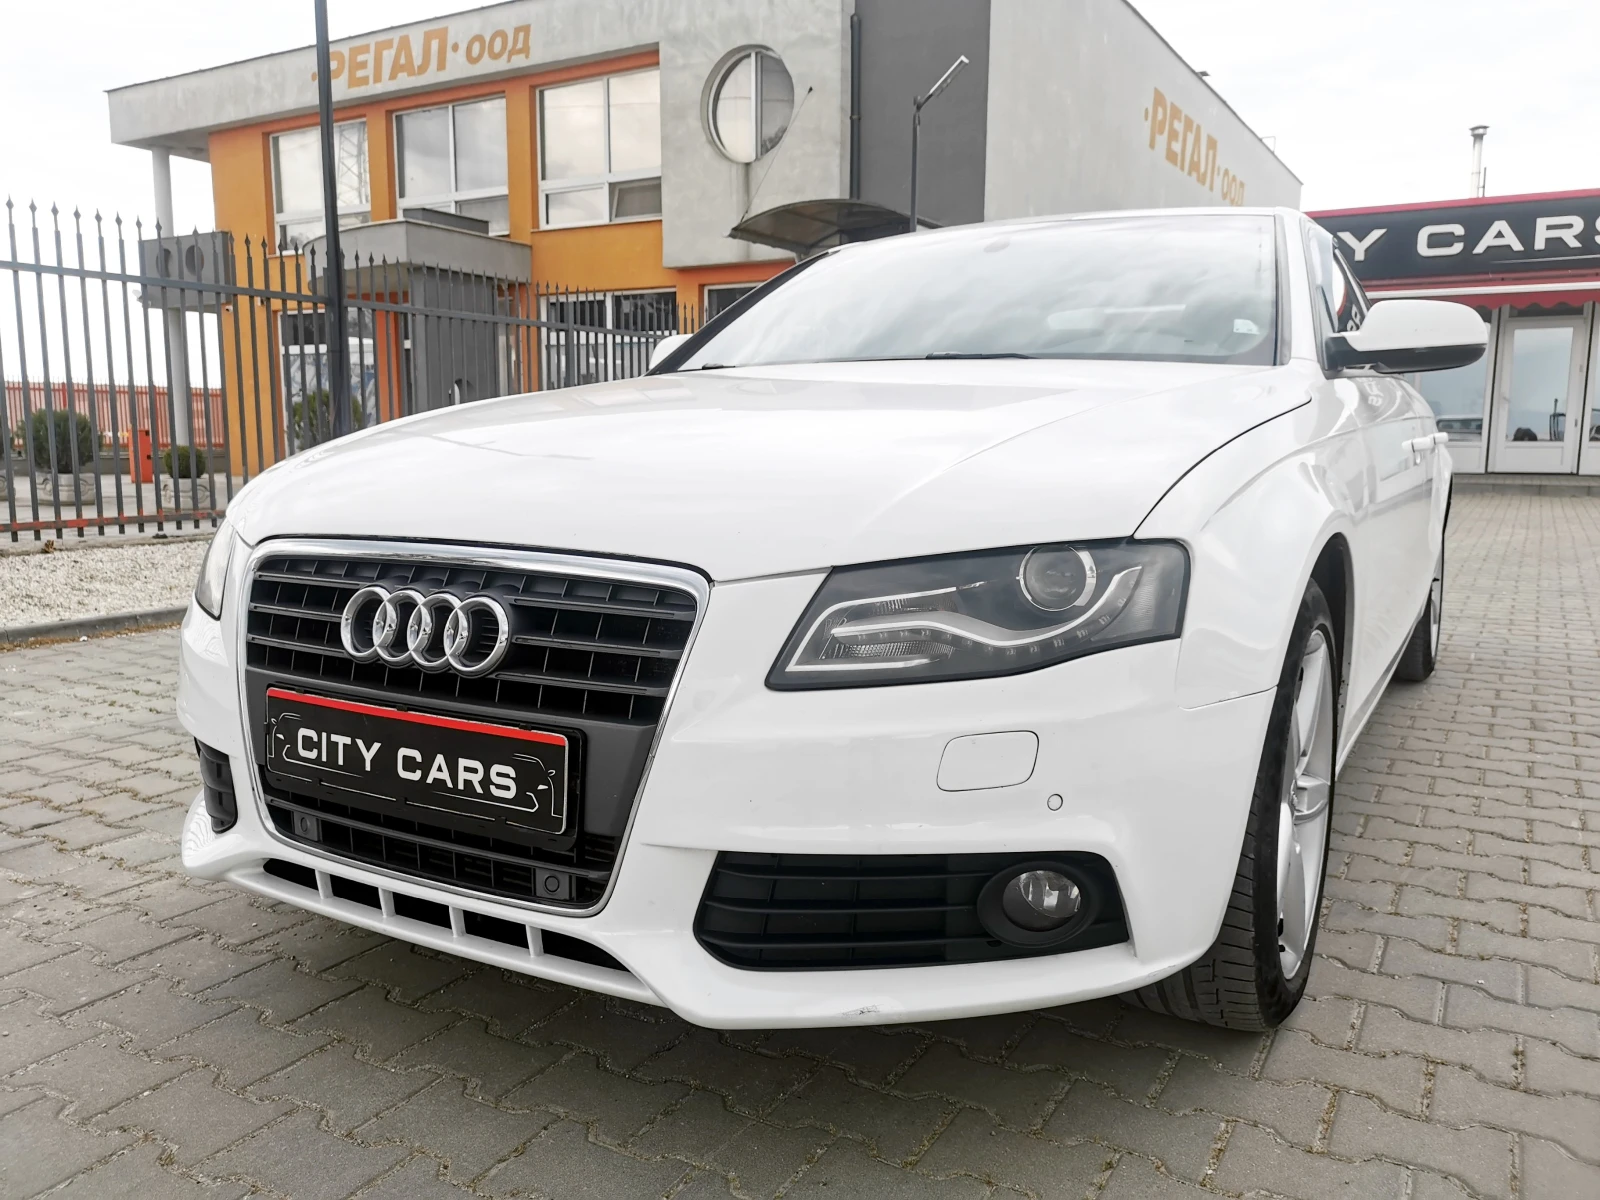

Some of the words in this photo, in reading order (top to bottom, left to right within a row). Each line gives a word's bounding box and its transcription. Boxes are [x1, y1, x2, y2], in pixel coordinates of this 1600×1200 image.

[1416, 214, 1600, 258] CAR
[297, 727, 382, 772] CITY
[396, 746, 517, 799] CARS
